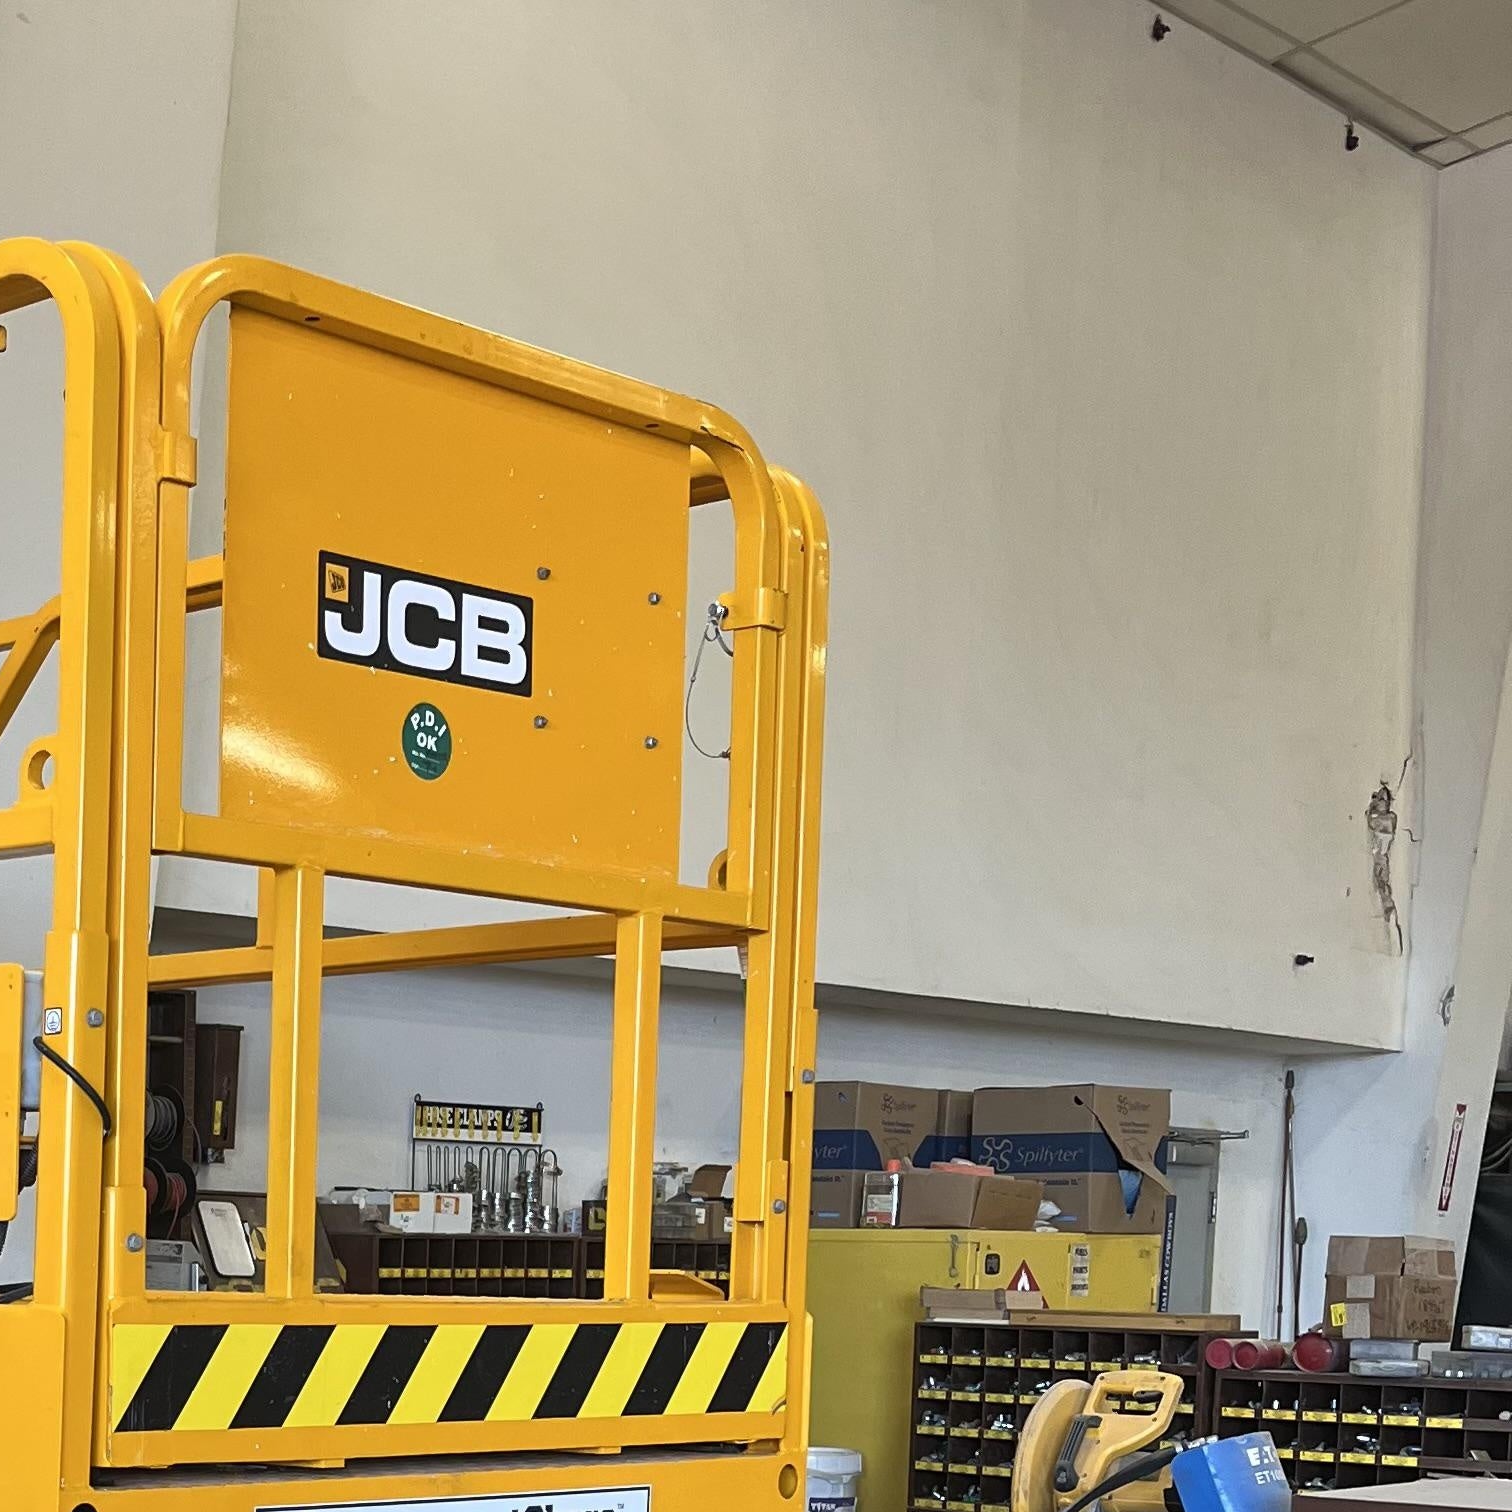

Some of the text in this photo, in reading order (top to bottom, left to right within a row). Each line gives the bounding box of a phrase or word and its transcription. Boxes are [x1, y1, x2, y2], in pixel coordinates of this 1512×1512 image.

[325, 570, 527, 685] JCB
[416, 732, 438, 752] OK
[810, 1501, 837, 1512] TITAN
